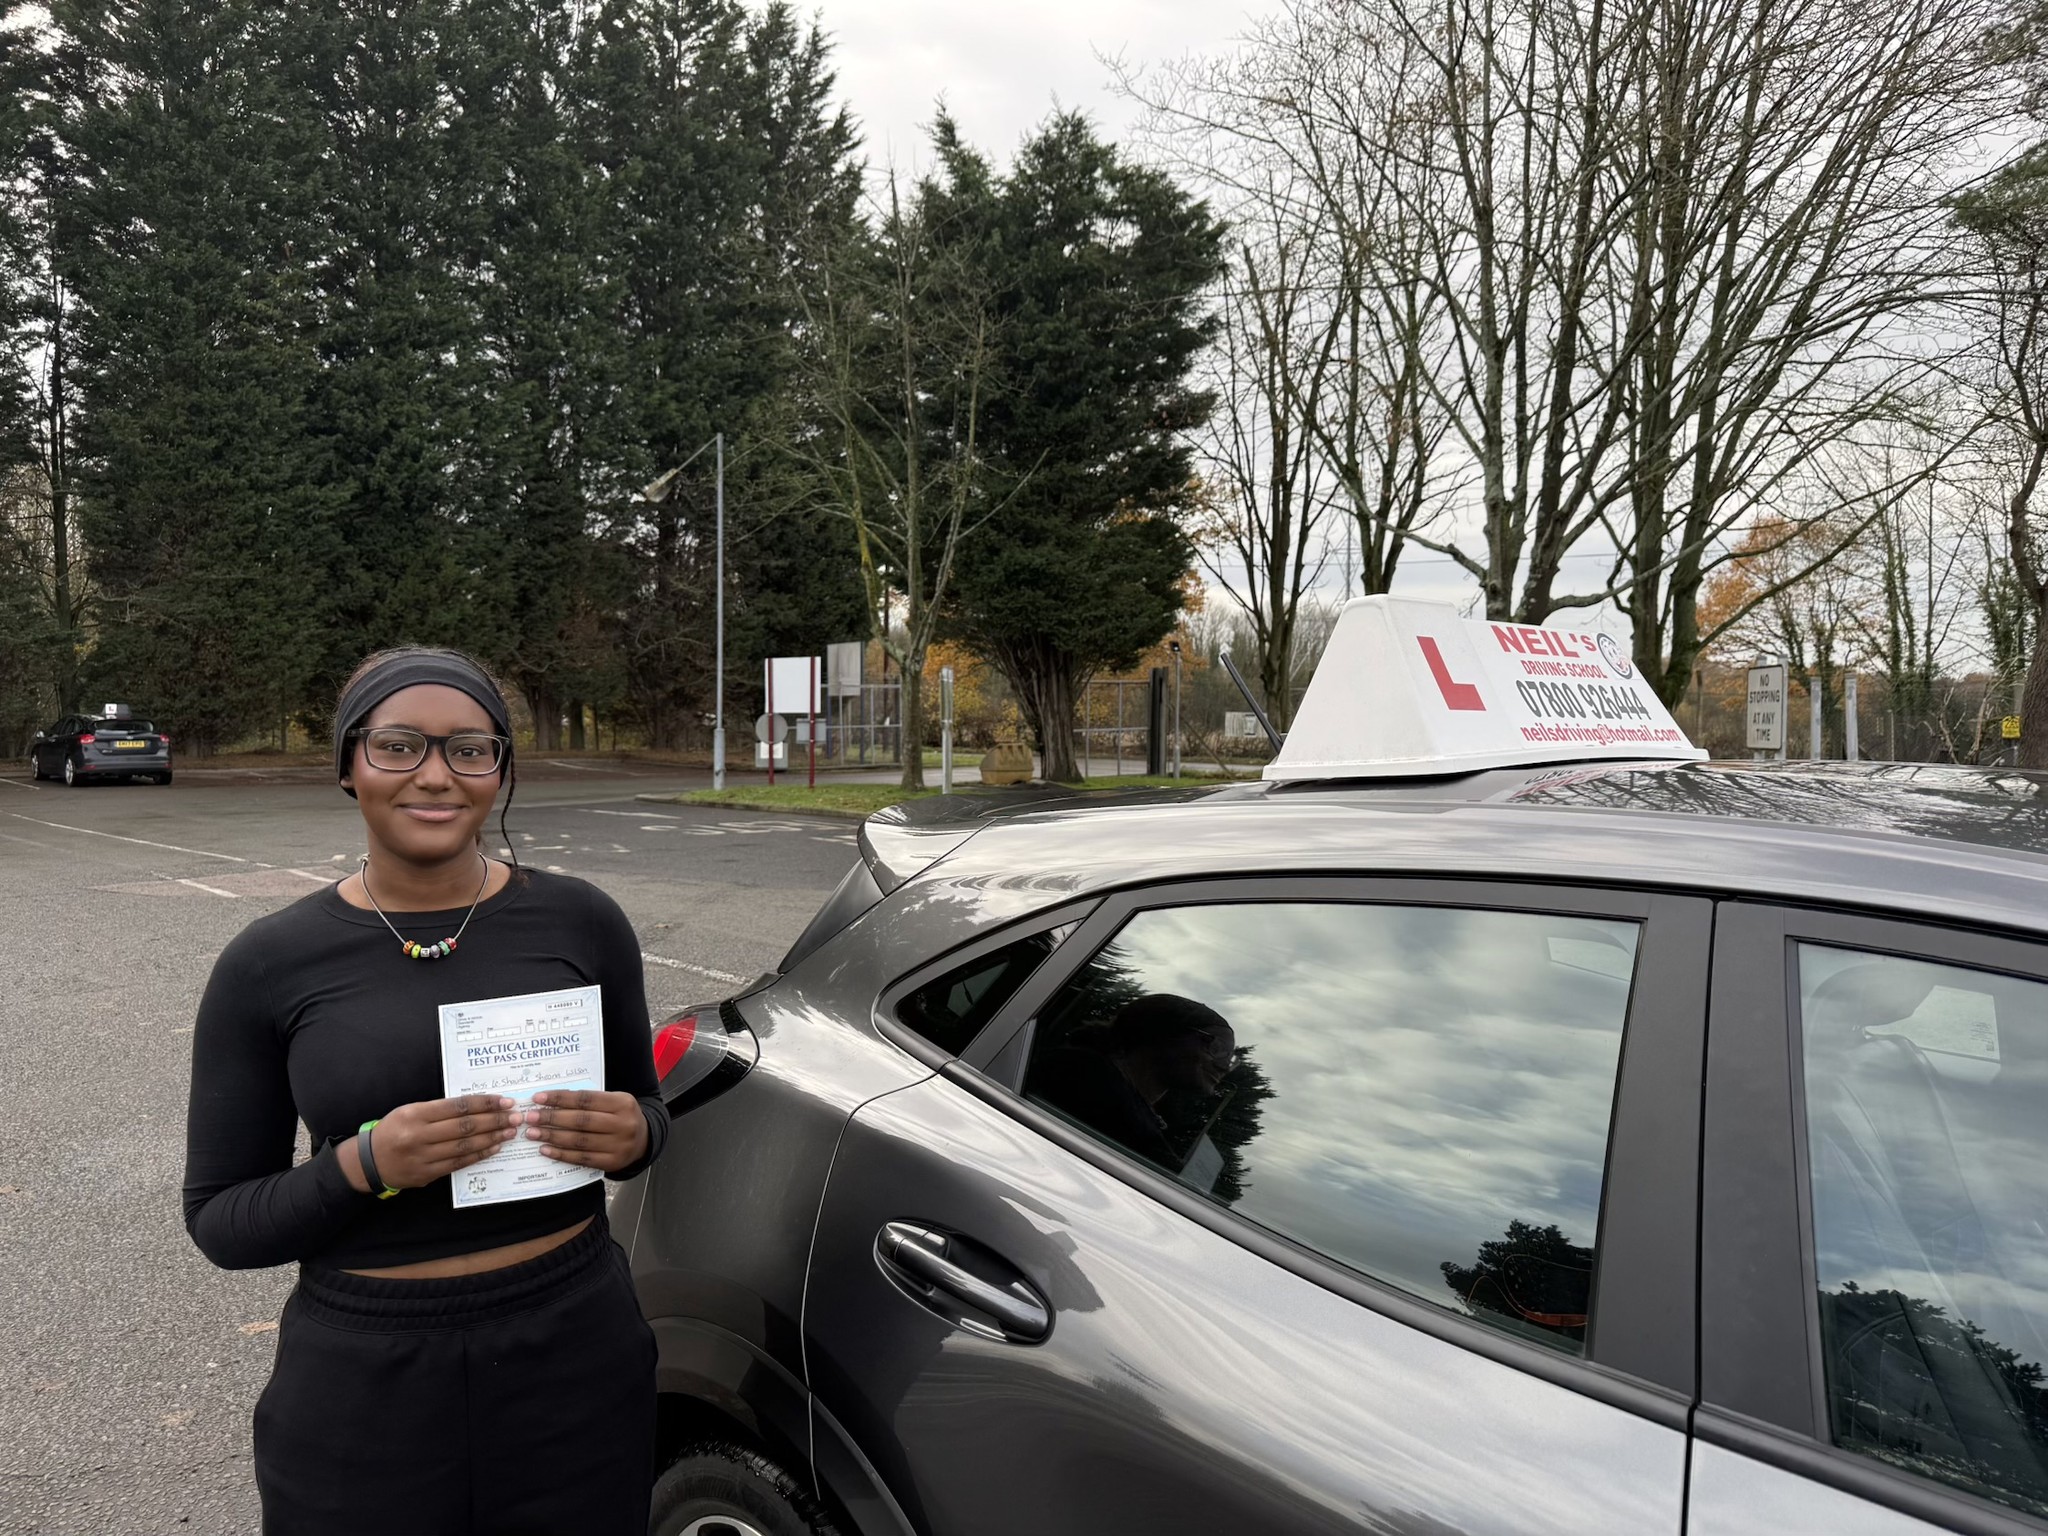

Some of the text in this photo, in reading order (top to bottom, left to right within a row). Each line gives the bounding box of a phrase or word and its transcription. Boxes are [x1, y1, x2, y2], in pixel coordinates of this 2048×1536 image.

[1491, 625, 1597, 658] NEIL's
[1417, 636, 1486, 711] L
[1520, 660, 1608, 679] DRIVING SCHOOL
[1760, 674, 1769, 687] NO
[1516, 680, 1652, 720] 07800 926444
[1749, 690, 1780, 704] STOPPING
[1753, 712, 1775, 725] AT ANY
[1520, 722, 1681, 746] neilsdriving@hotmail.com
[1756, 728, 1770, 741] TIME
[467, 1033, 580, 1057] PRACTICAL DRIVING
[468, 1044, 580, 1067] TEST PASS CERTIFICATE
